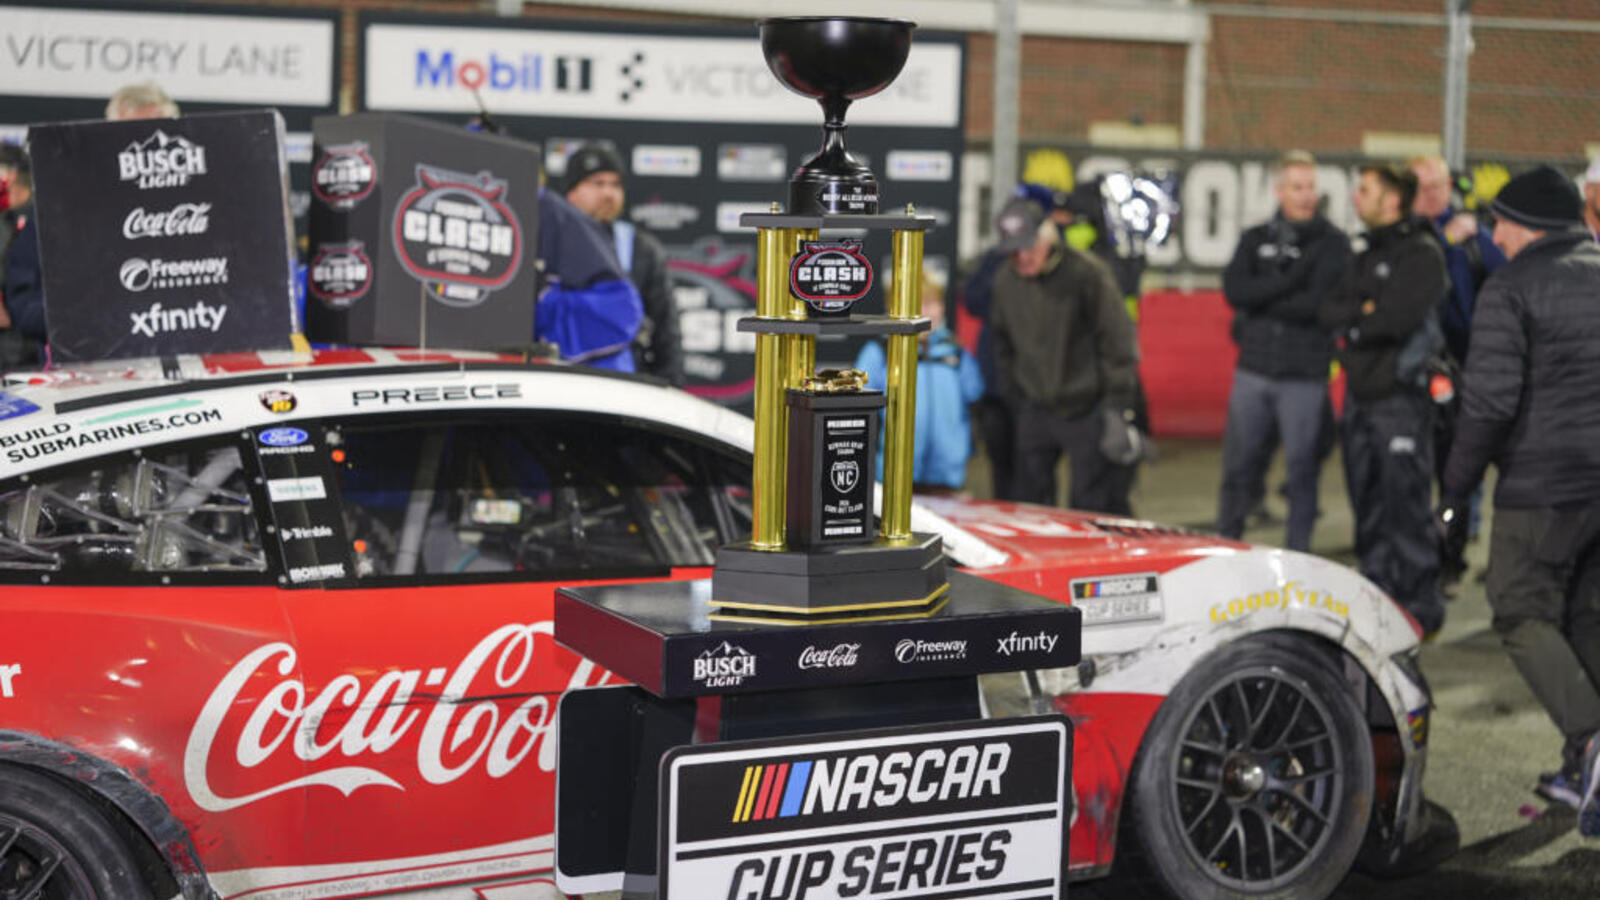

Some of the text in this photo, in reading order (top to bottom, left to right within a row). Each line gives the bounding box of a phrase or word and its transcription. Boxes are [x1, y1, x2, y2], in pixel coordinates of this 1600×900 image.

[6, 35, 302, 79] VICTORY LANE
[415, 50, 543, 91] Mobil
[665, 64, 772, 98] VICTO
[118, 146, 208, 181] BUSCH
[138, 173, 187, 190] LIGHT
[403, 209, 514, 256] CLASH
[152, 257, 228, 279] Freeway
[797, 266, 867, 282] CLASH
[130, 301, 228, 337] xfinity
[352, 383, 522, 407] PREECE
[0, 421, 71, 448] BUILD
[6, 408, 223, 464] SUBMARINES.COM
[1209, 580, 1349, 624] GOODYEAR
[798, 643, 862, 670] Coca-Cola
[915, 639, 967, 654] Freeway
[915, 652, 967, 662] INSURANCE
[997, 631, 1058, 656] xfinity
[693, 654, 756, 681] BUSCH
[705, 676, 742, 688] LIGHT
[802, 742, 1011, 816] NASCAR
[727, 829, 1011, 900] CUP SERIES
